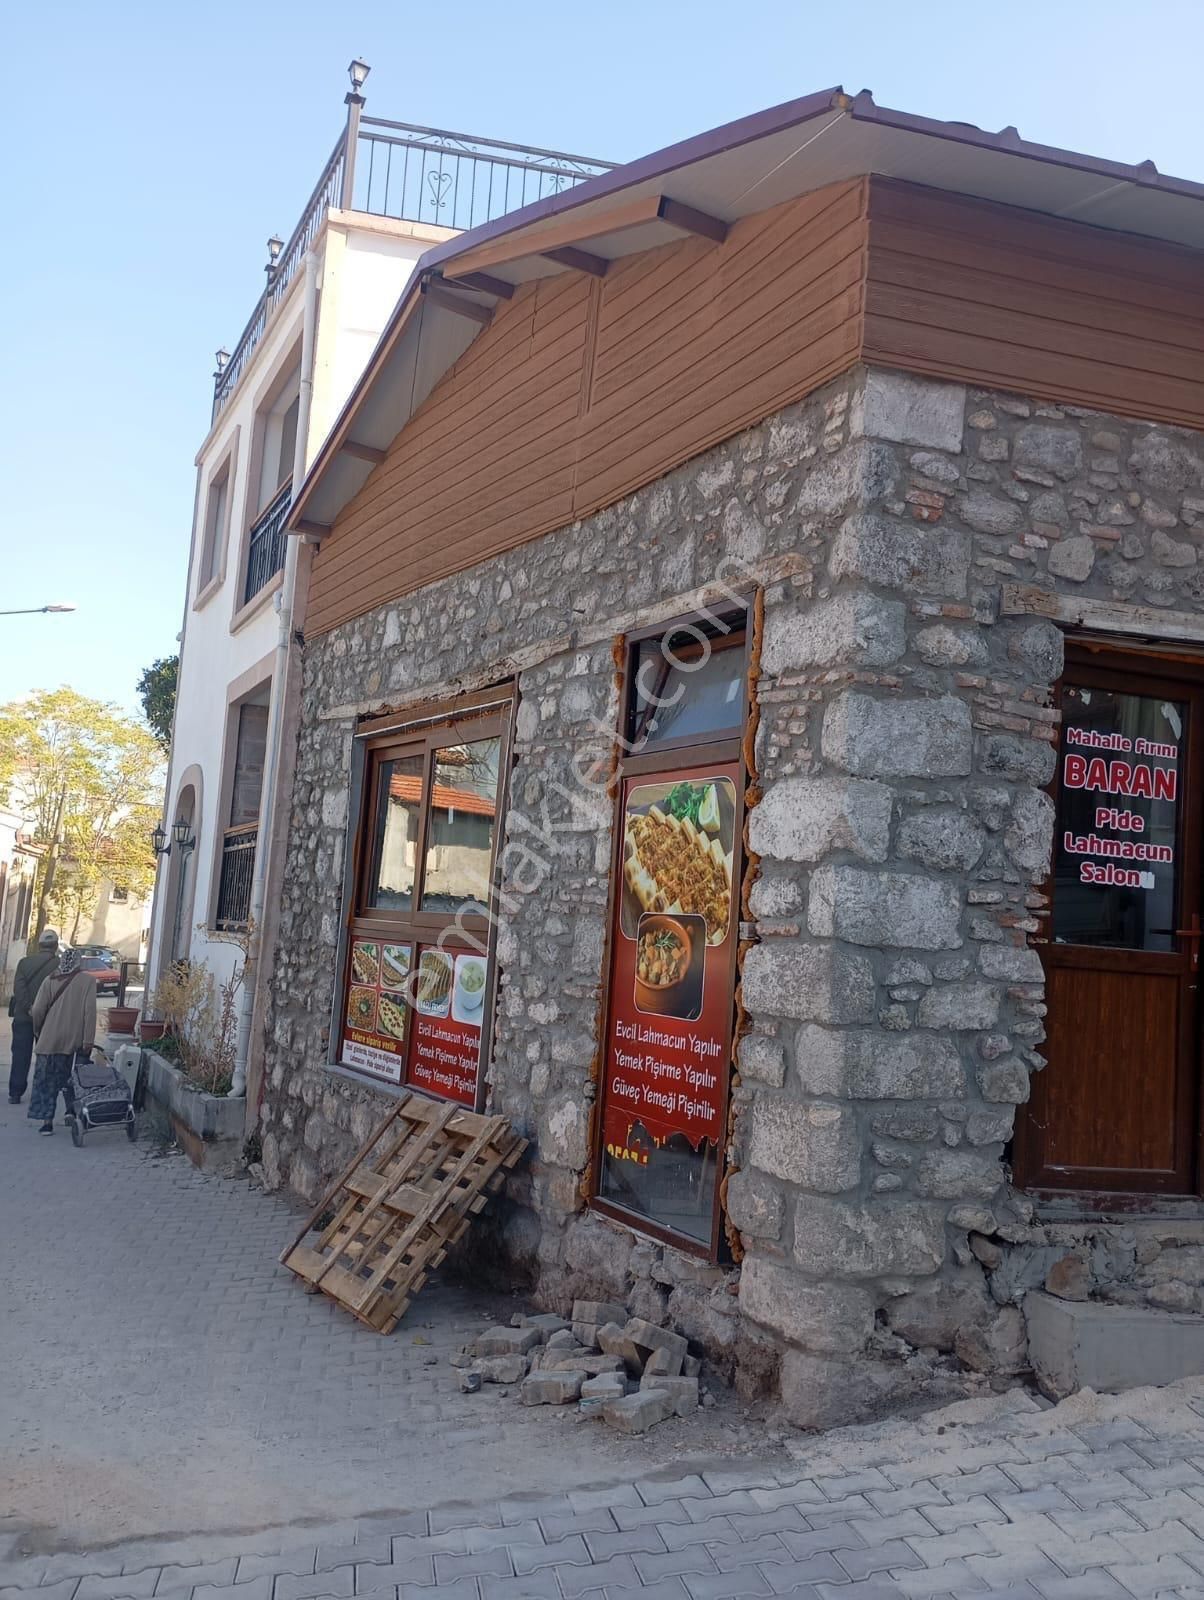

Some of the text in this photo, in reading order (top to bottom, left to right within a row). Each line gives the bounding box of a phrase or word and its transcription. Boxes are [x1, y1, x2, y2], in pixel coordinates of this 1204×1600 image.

[1066, 727, 1132, 752] Mahalle
[1064, 754, 1177, 801] BARAN
[1095, 807, 1144, 832] Pide
[1064, 832, 1173, 863] Lahmacun
[418, 1022, 431, 1037] Evcil
[431, 1025, 461, 1044] Lahmacun
[616, 1020, 721, 1062] Evcil Lahmacun Yapılır
[417, 1041, 435, 1059] Yemek
[435, 1047, 457, 1065] Pişirme
[415, 1062, 433, 1083] Güveç
[433, 1067, 453, 1089] Yemeği
[614, 1048, 717, 1092] Yemek Pişirme Yapılır
[612, 1077, 716, 1121] Güveç Yemeği Pişirilir
